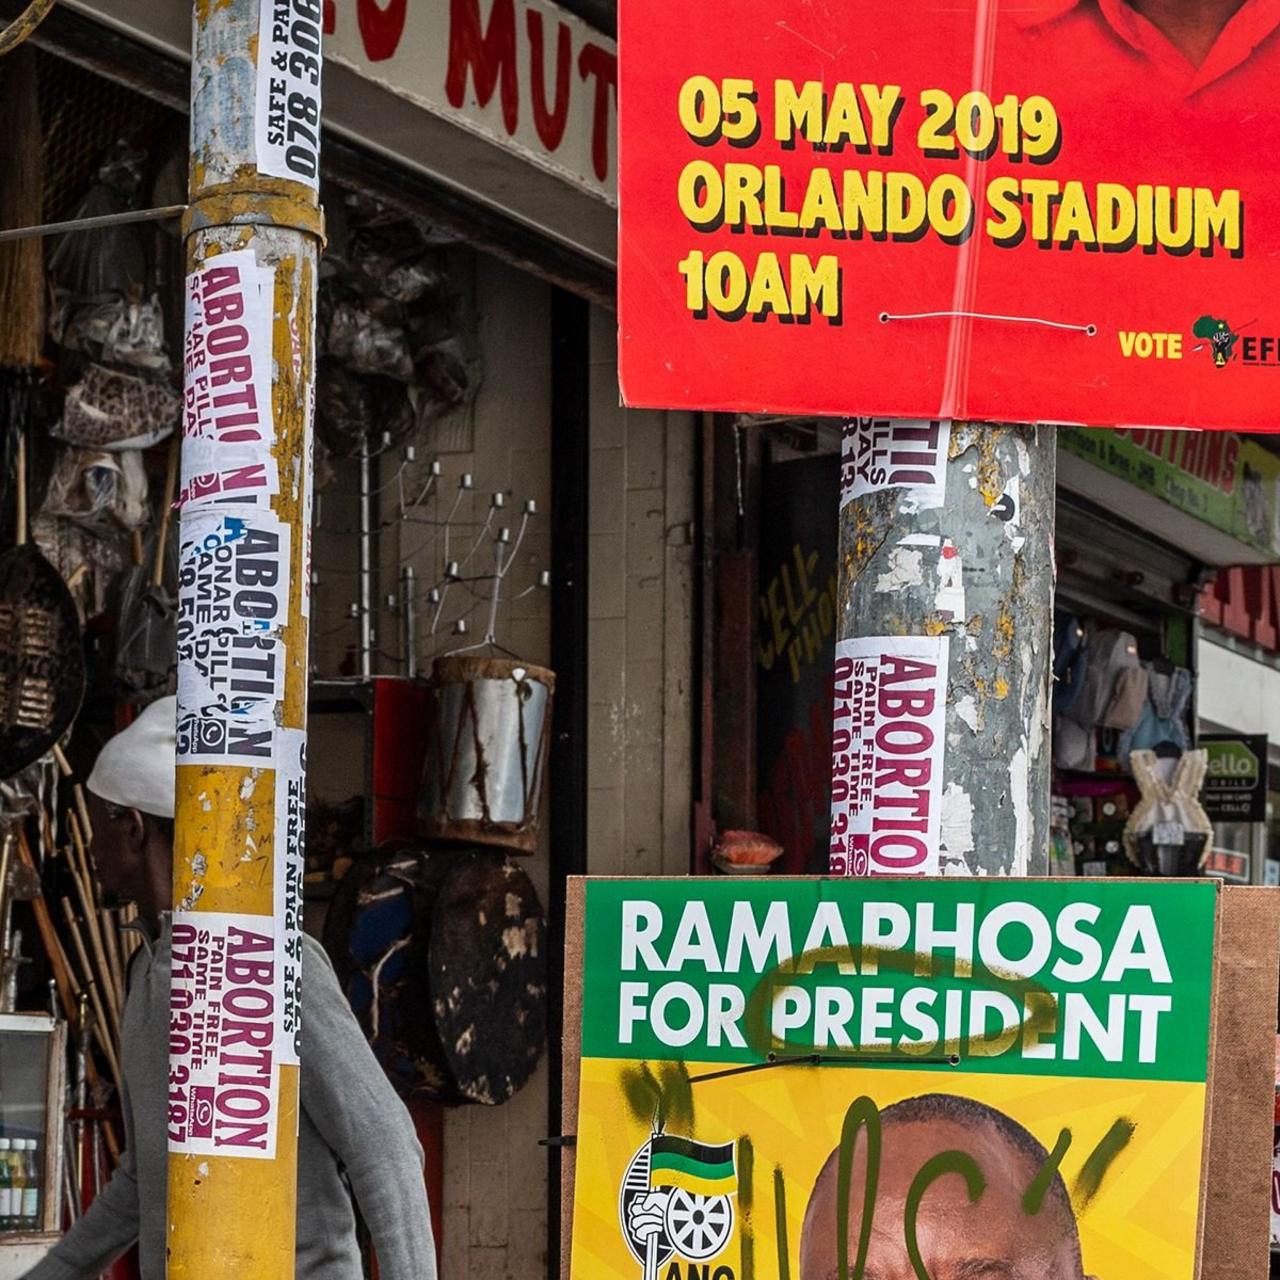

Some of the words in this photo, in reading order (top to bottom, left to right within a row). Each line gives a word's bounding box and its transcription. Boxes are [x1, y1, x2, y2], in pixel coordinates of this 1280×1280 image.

[271, 51, 287, 71] &
[268, 78, 287, 146] SAFE
[285, 92, 318, 179] 078
[678, 75, 758, 143] 05
[774, 80, 902, 153] MAY
[917, 89, 1062, 165] 2019
[678, 160, 973, 244] ORLANDO
[986, 177, 1244, 257] STADIUM
[678, 249, 842, 326] 10AM
[1119, 331, 1183, 359] VOTE
[195, 553, 214, 625] AME
[212, 546, 233, 630] ONAR
[851, 661, 865, 740] SAME
[863, 666, 878, 728] PAIN
[848, 751, 863, 817] TIME
[870, 654, 937, 877] ABORTIO
[286, 779, 300, 858] FREE
[285, 863, 297, 932] PAIN
[195, 930, 210, 1000] SAME
[209, 937, 225, 991] PAIN
[284, 940, 296, 960] &
[619, 900, 1173, 984] RAMAPHOSA
[284, 965, 296, 1033] SAFE
[618, 980, 749, 1049] FOR
[771, 985, 1173, 1064] PRESIDENT
[191, 1010, 205, 1070] TIME
[214, 926, 275, 1150] ABORTION
